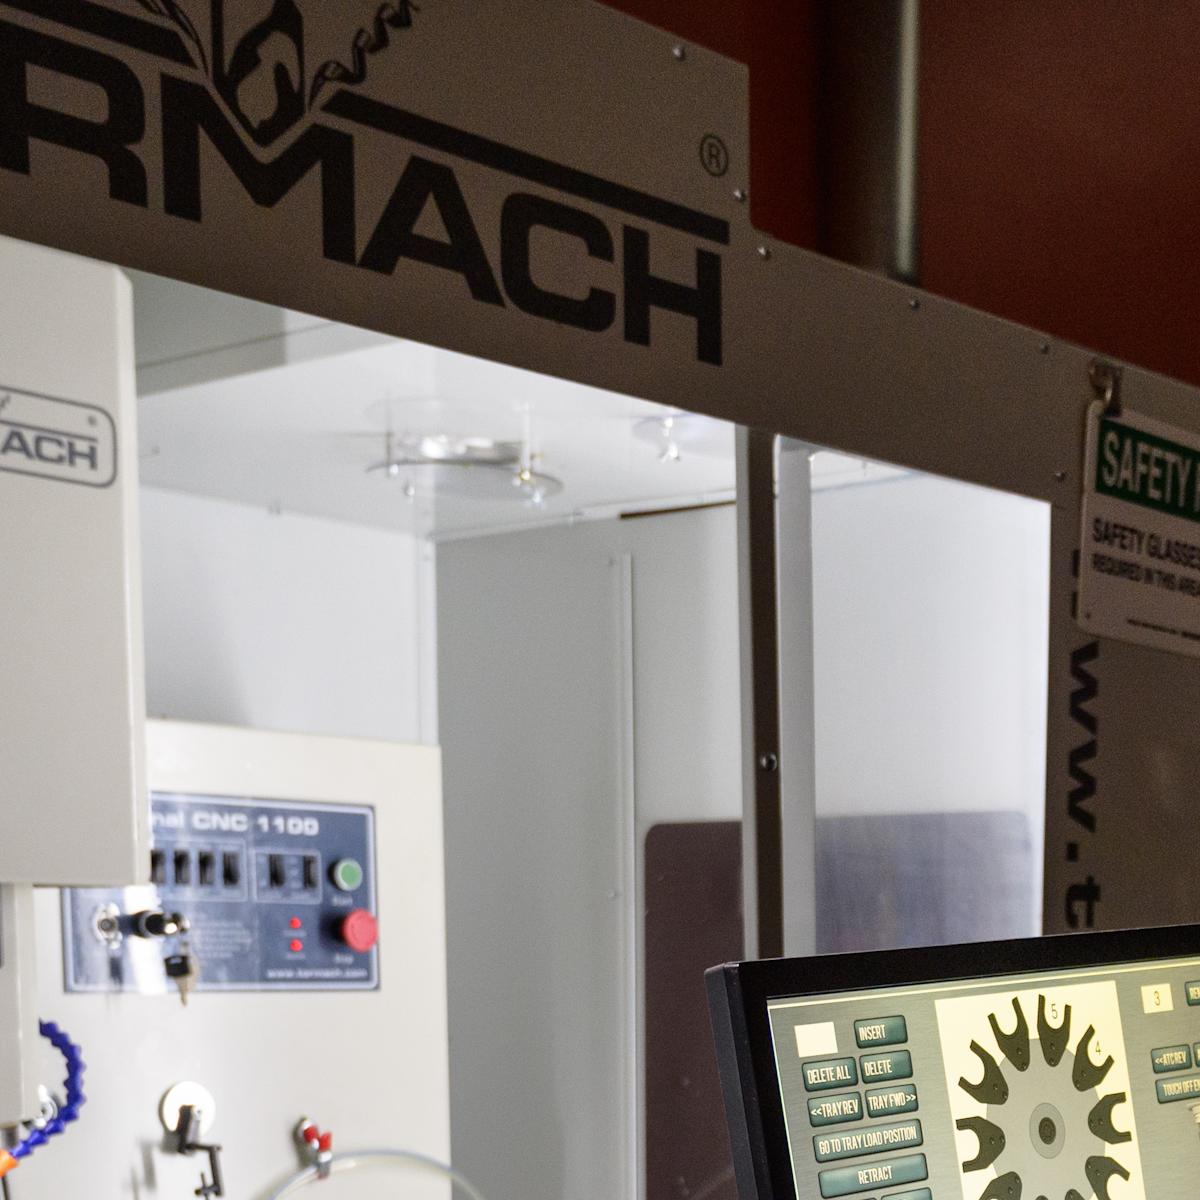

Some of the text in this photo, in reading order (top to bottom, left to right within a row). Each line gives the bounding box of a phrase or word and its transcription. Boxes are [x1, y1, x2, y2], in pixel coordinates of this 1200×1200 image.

[1102, 430, 1192, 508] SAFETY
[1093, 517, 1144, 554] SAFETY
[192, 811, 248, 833] CNC
[257, 816, 319, 836] 1100
[1153, 990, 1161, 1006] 3
[1050, 1003, 1058, 1020] 5
[859, 1024, 887, 1041] INSERT
[807, 1065, 851, 1084] DELETE ALL
[864, 1060, 892, 1076] DELETE
[843, 1099, 858, 1115] REV
[868, 1095, 889, 1110] TRAY
[819, 1126, 917, 1154] GO TO TRAY LOAD POSITION
[857, 1166, 893, 1184] RETRACT
